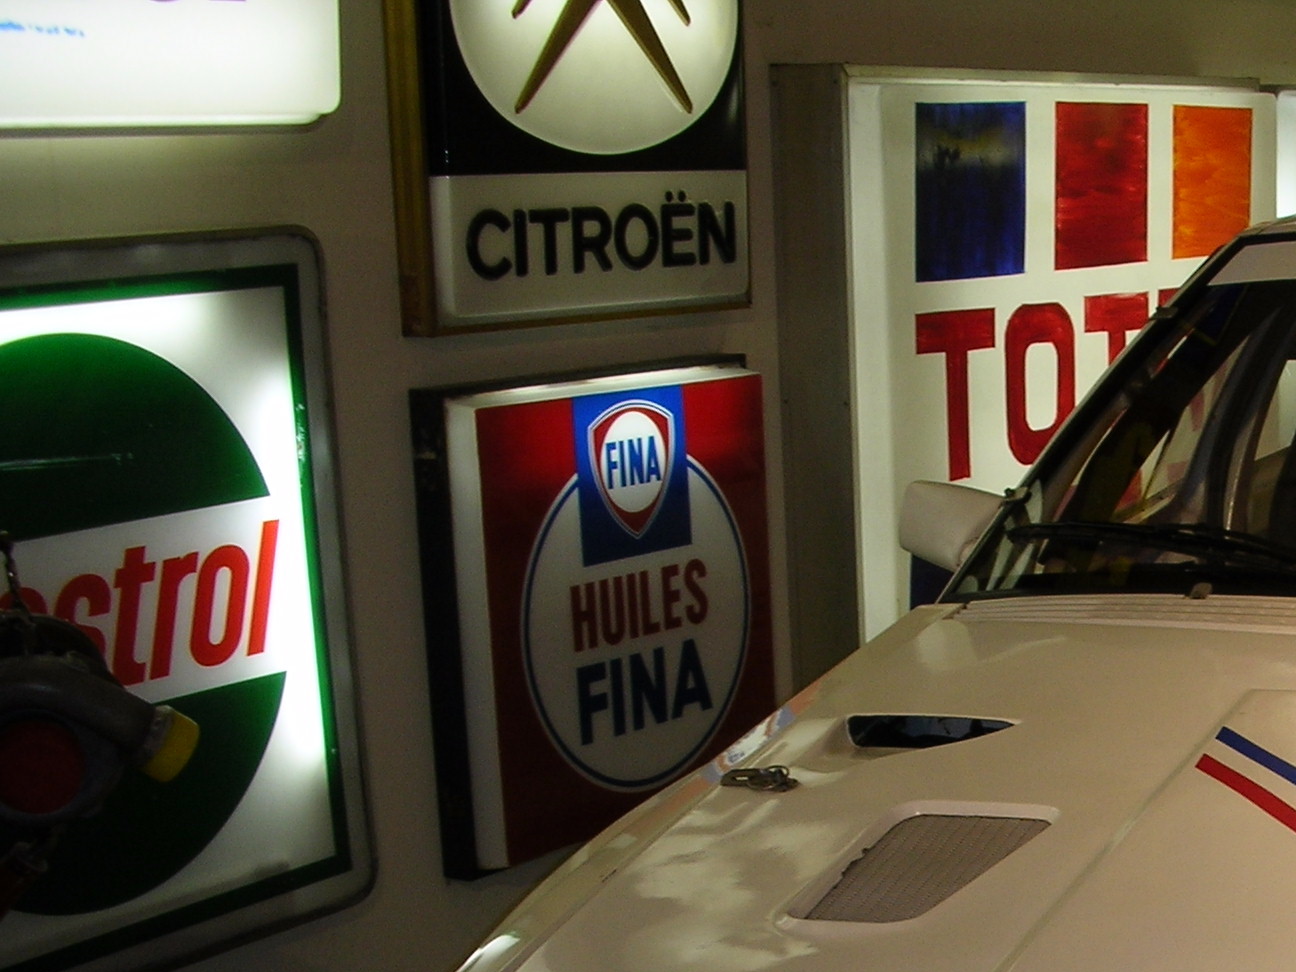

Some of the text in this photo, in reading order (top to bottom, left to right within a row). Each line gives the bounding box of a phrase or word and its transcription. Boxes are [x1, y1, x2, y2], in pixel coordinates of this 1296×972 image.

[466, 190, 737, 281] CITROËN
[605, 434, 662, 490] FINA
[569, 558, 708, 653] HUILES
[576, 639, 713, 747] FINA
